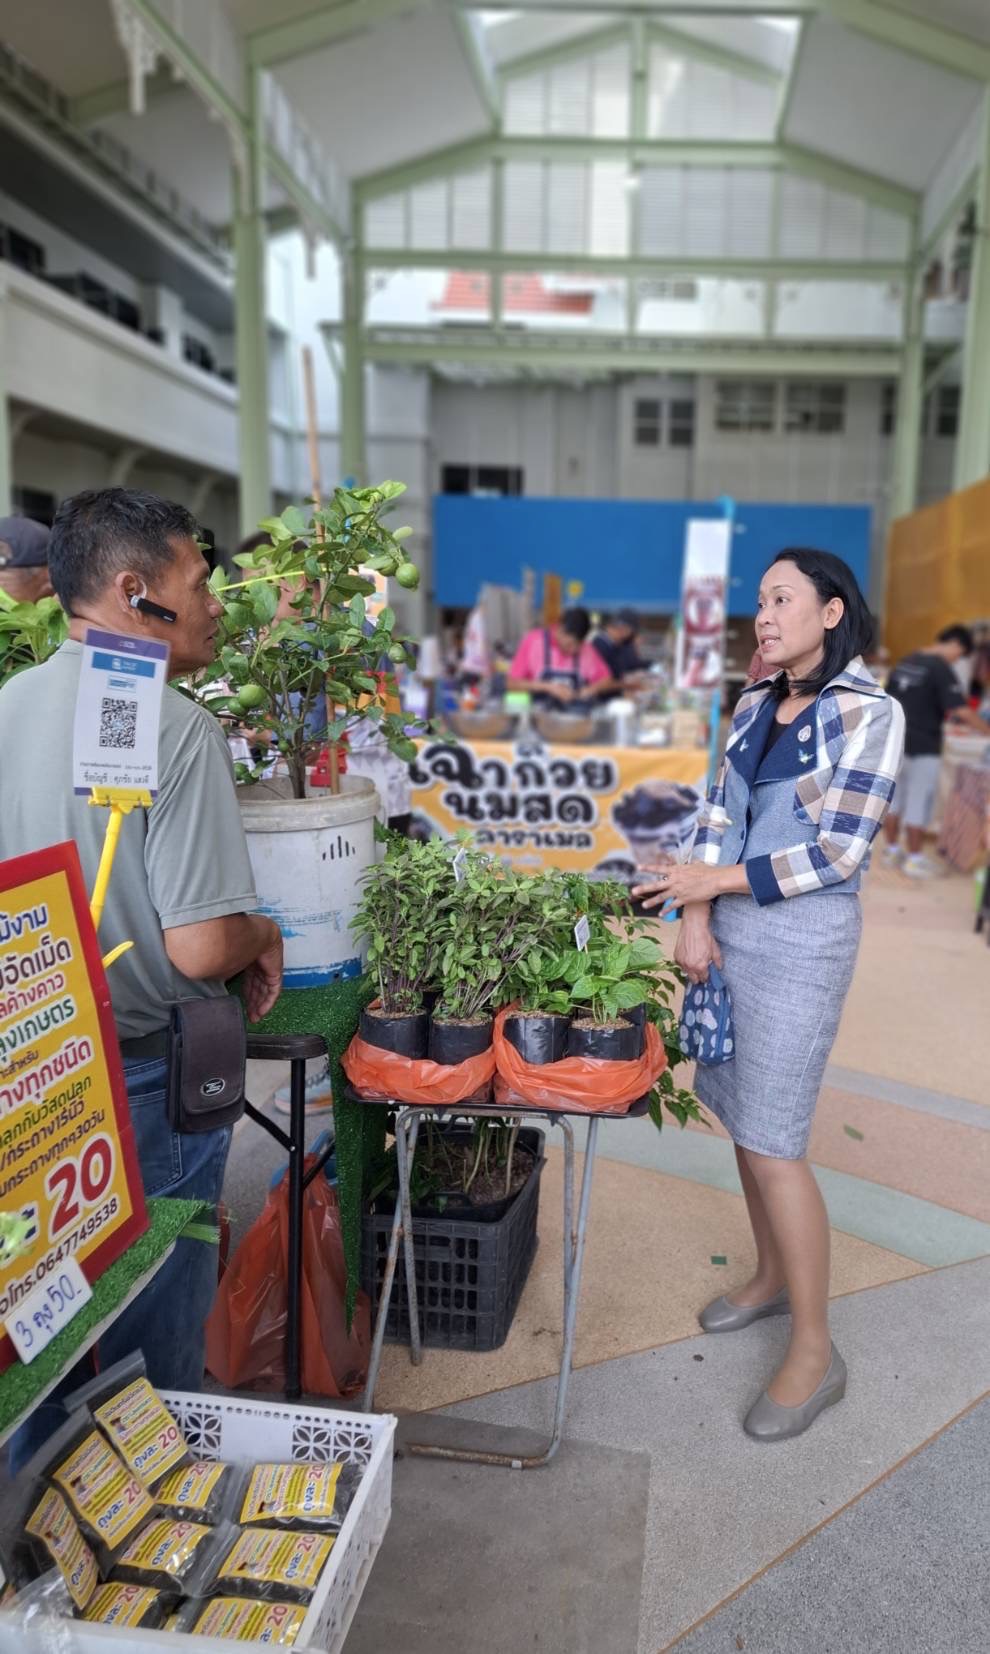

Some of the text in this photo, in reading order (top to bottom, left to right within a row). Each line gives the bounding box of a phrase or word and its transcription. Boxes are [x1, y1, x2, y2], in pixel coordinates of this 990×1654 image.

[445, 793, 594, 823] นมสด
[48, 1138, 112, 1235] 20
[15, 1320, 33, 1347] 3
[157, 1425, 178, 1450] 20
[309, 1464, 324, 1479] 20
[123, 1480, 141, 1505] 20
[170, 1523, 192, 1538] 20
[297, 1536, 316, 1551] 20
[118, 1586, 140, 1602] 20
[266, 1606, 288, 1626] 20
